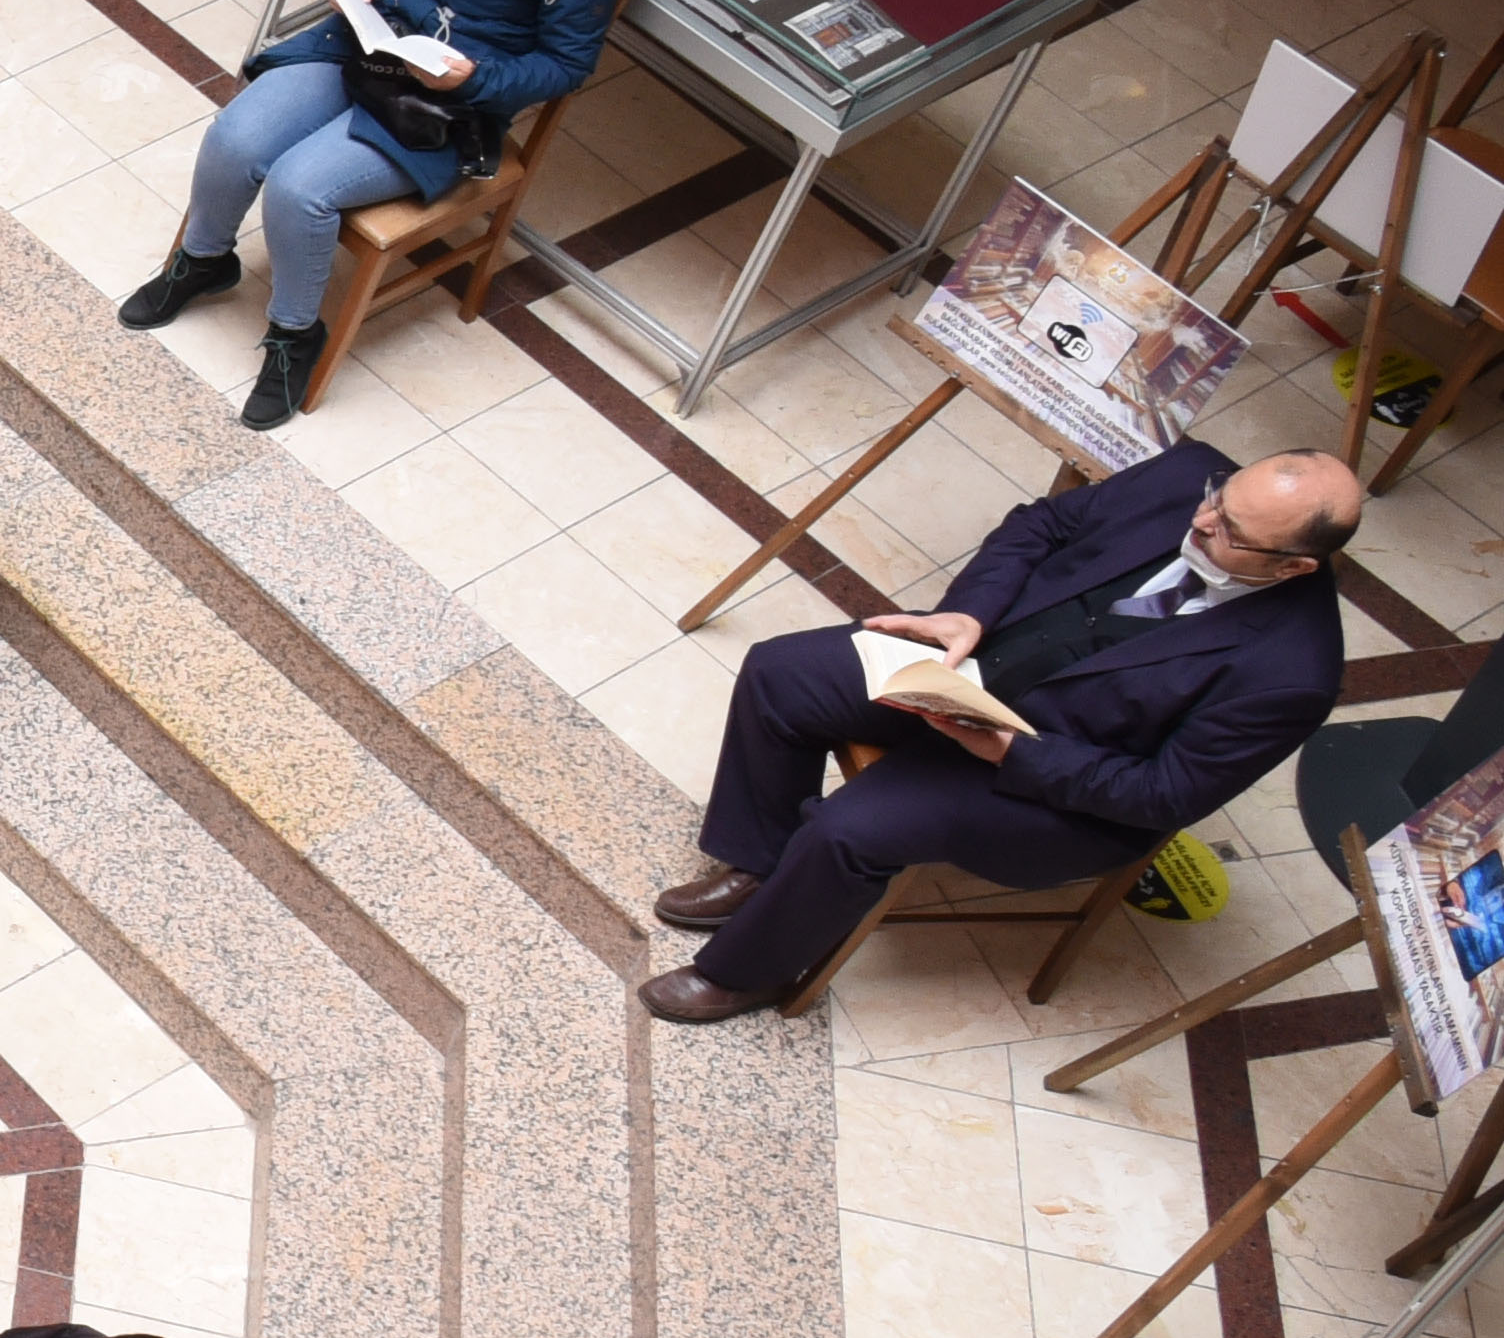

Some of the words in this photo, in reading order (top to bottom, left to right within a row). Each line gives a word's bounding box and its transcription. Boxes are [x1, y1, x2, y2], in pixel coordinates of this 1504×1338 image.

[1387, 839, 1426, 939] KÜTÜPHANEDEKİ
[1418, 935, 1447, 1006] YAYINLARIN
[1388, 886, 1424, 979] KOPYALANMASI
